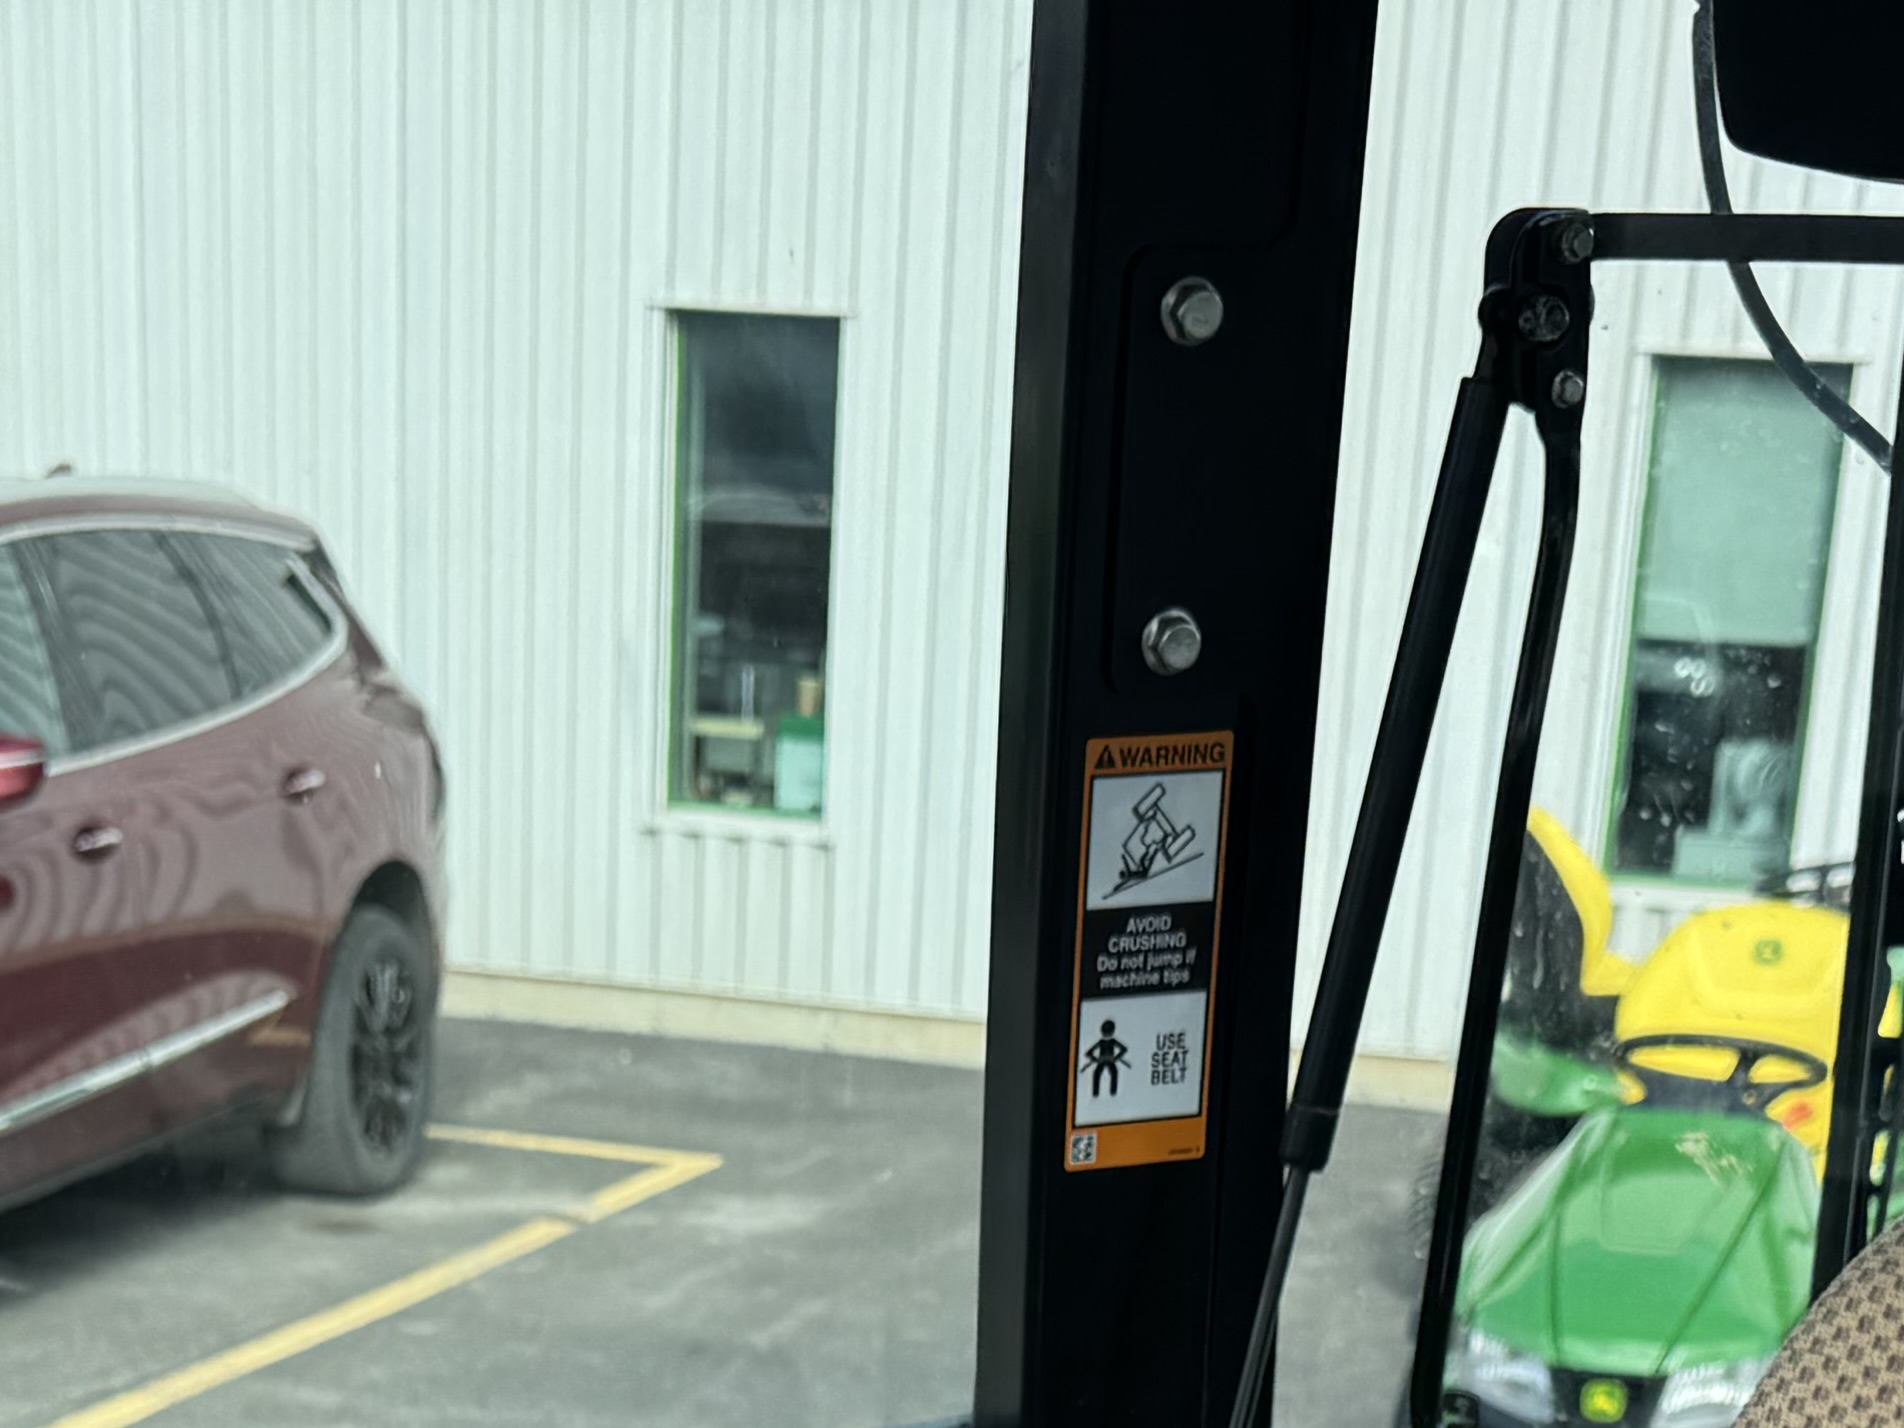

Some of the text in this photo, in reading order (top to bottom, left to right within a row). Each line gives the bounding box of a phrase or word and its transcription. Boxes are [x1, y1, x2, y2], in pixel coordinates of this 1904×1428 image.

[1119, 743, 1225, 767] WARNING
[1127, 916, 1171, 933] AVOID
[1108, 931, 1187, 952] CRUSHING
[1097, 955, 1117, 972] Do
[1121, 953, 1143, 969] not
[1147, 952, 1182, 971] jump
[1100, 968, 1189, 988] machine tips
[1156, 1033, 1185, 1051] USE
[1151, 1050, 1188, 1068] SEAT
[1151, 1068, 1187, 1085] BELT
